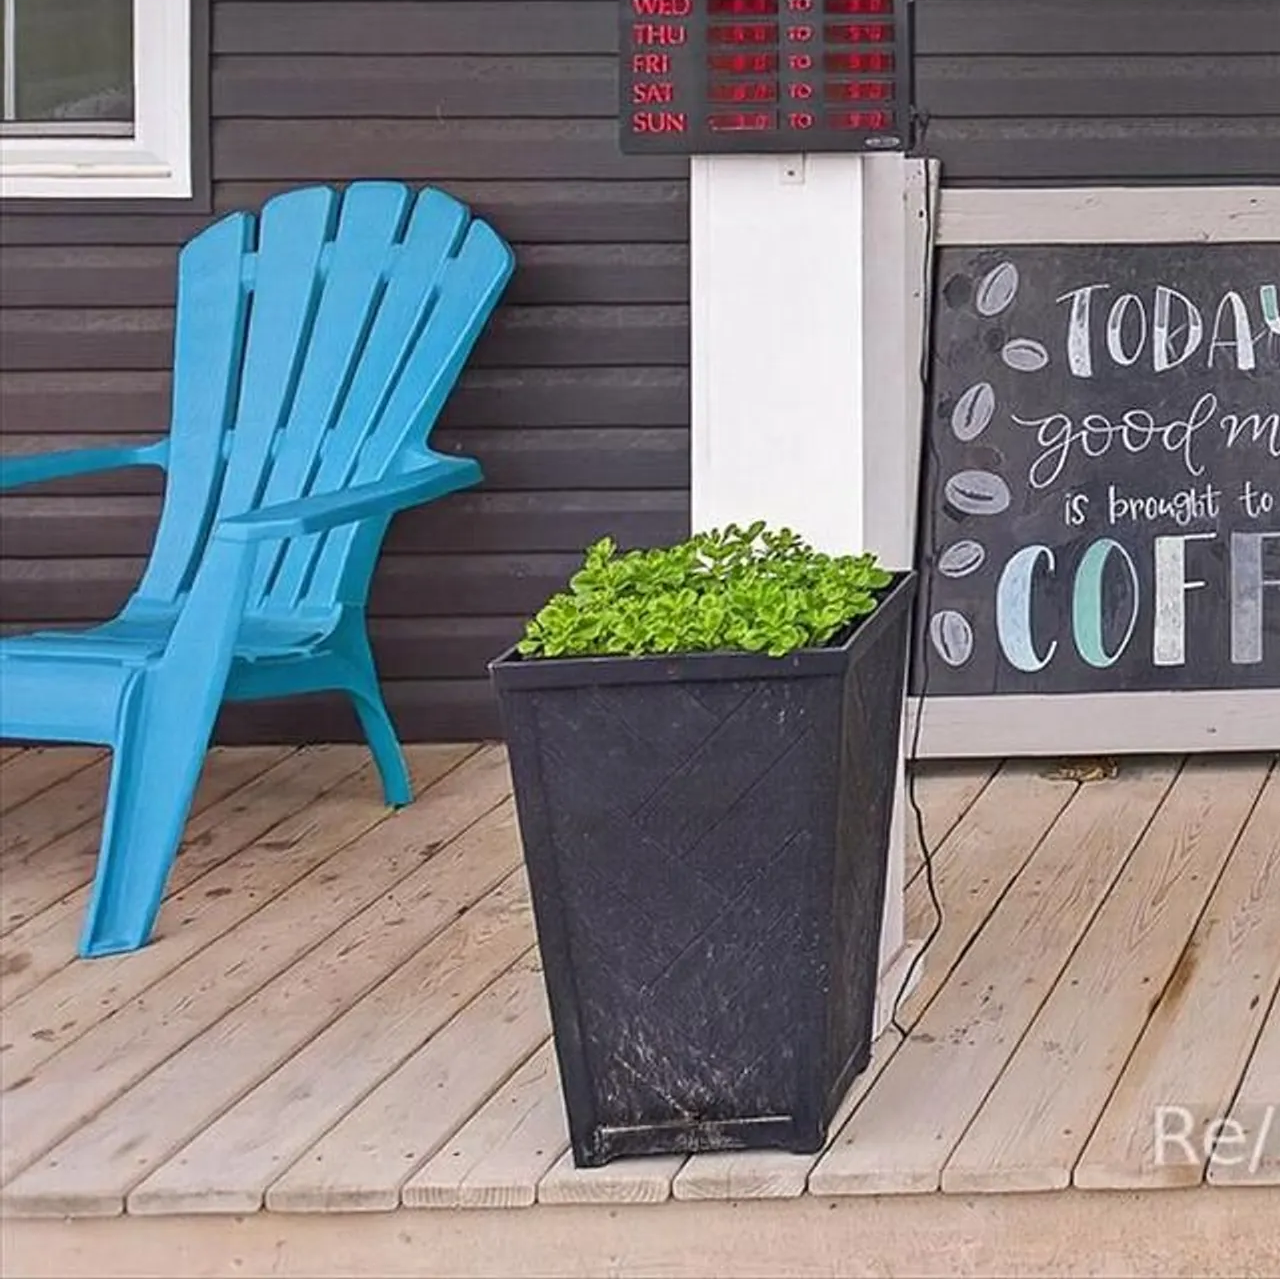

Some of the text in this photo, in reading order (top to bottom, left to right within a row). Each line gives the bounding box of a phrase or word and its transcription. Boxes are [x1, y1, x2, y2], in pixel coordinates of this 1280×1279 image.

[632, 24, 687, 45] THU
[786, 25, 812, 41] TO
[632, 54, 668, 74] FRI
[787, 53, 812, 69] TO
[632, 83, 673, 103] SAT
[787, 82, 812, 99] TO
[631, 112, 686, 133] SUN
[787, 112, 812, 129] TO
[1010, 392, 1218, 489] good
[1063, 492, 1090, 525] is
[1108, 483, 1223, 526] brought
[1238, 480, 1274, 518] to
